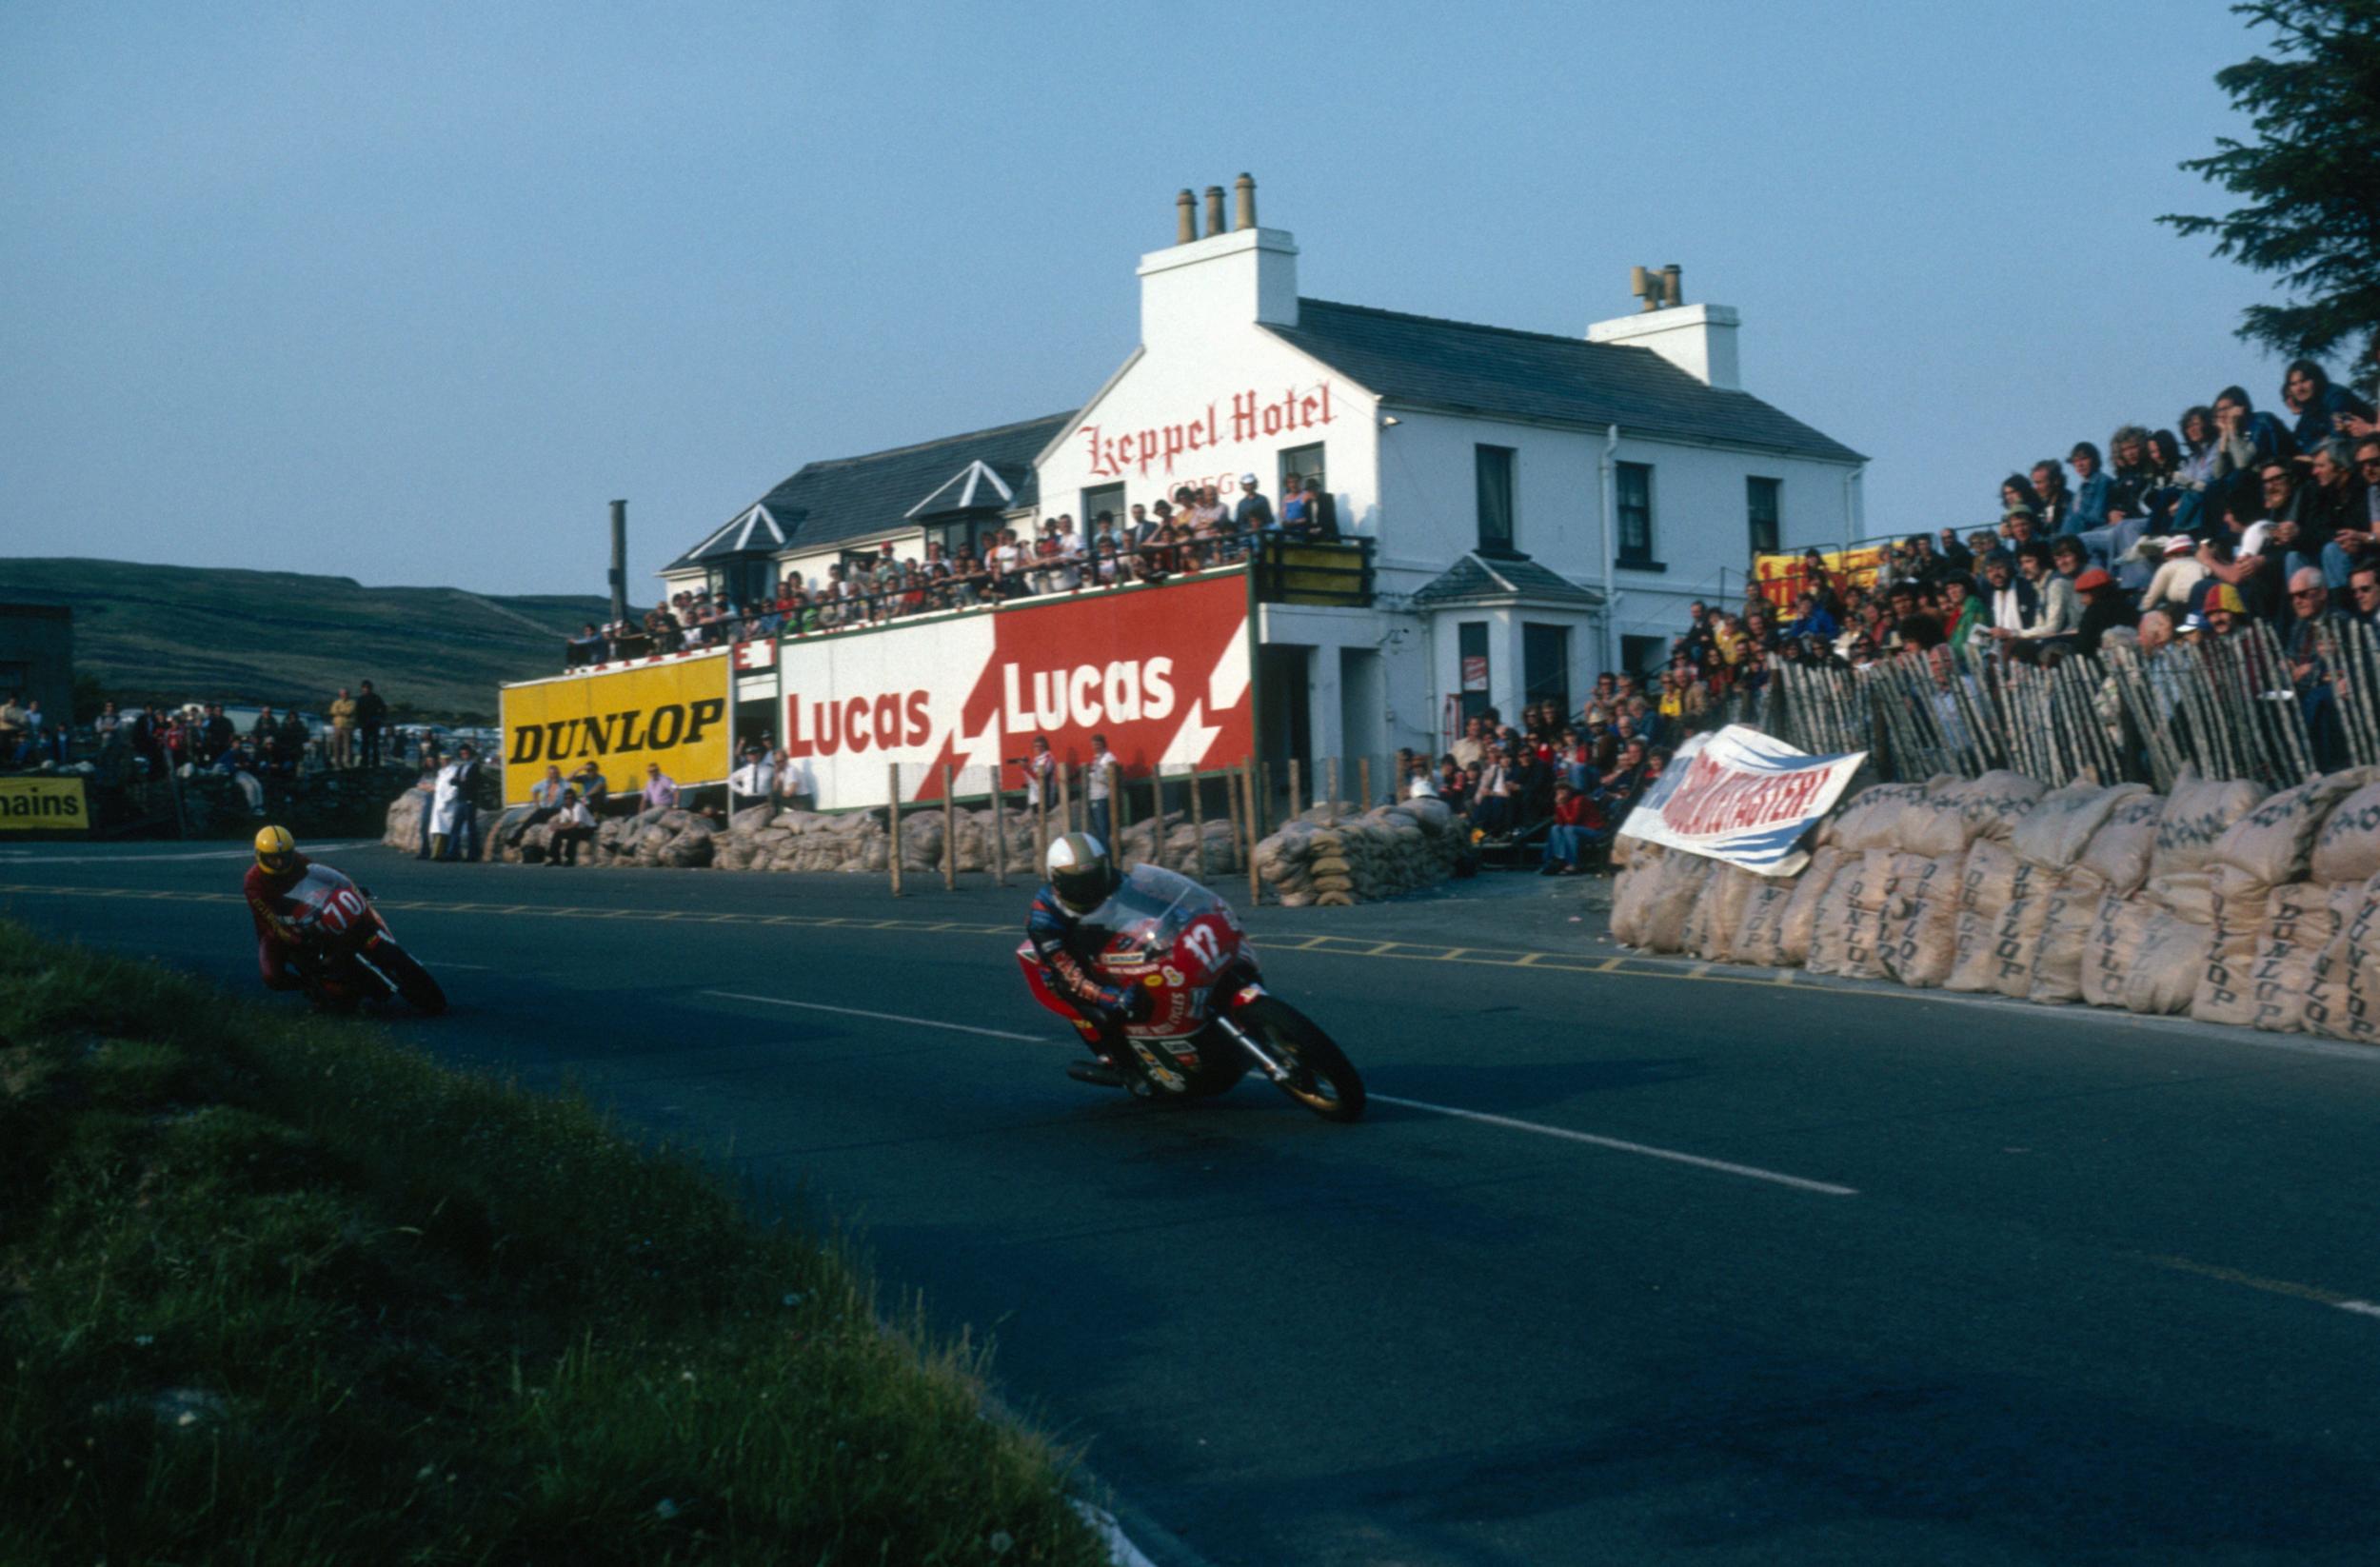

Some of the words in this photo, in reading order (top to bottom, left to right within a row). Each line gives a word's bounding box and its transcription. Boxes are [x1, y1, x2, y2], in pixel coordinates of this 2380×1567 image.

[1077, 401, 1222, 478] Keppel
[1230, 380, 1339, 443] Hotel
[788, 689, 932, 759] Lucas
[1003, 656, 1176, 734] Lucas
[509, 698, 725, 764] DUNLOP
[323, 890, 364, 930] 70
[1183, 922, 1231, 973] 12
[2255, 903, 2302, 1026] DUNLOP
